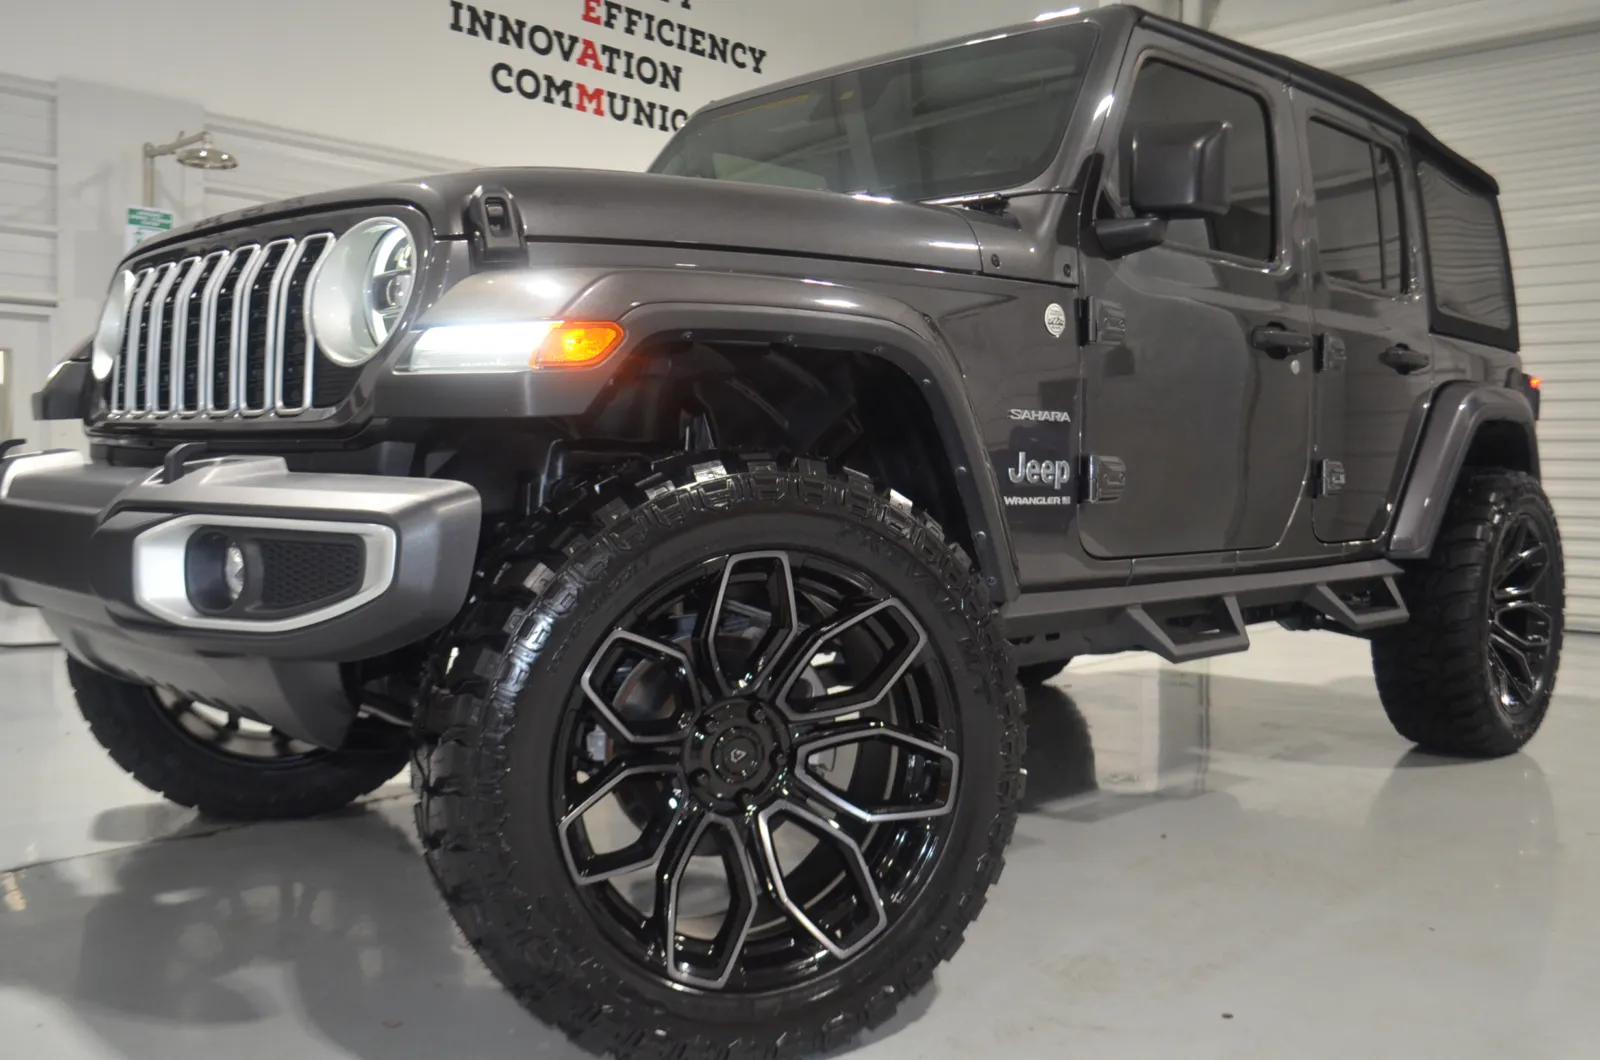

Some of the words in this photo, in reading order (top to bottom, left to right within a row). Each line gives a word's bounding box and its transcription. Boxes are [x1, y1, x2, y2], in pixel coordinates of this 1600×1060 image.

[449, 1, 682, 92] INNOVATION
[582, 0, 766, 73] EFFICIENCY
[1009, 409, 1071, 423] SAHARA
[1008, 451, 1071, 490] Jeep
[1004, 496, 1061, 506] WRANGLER
